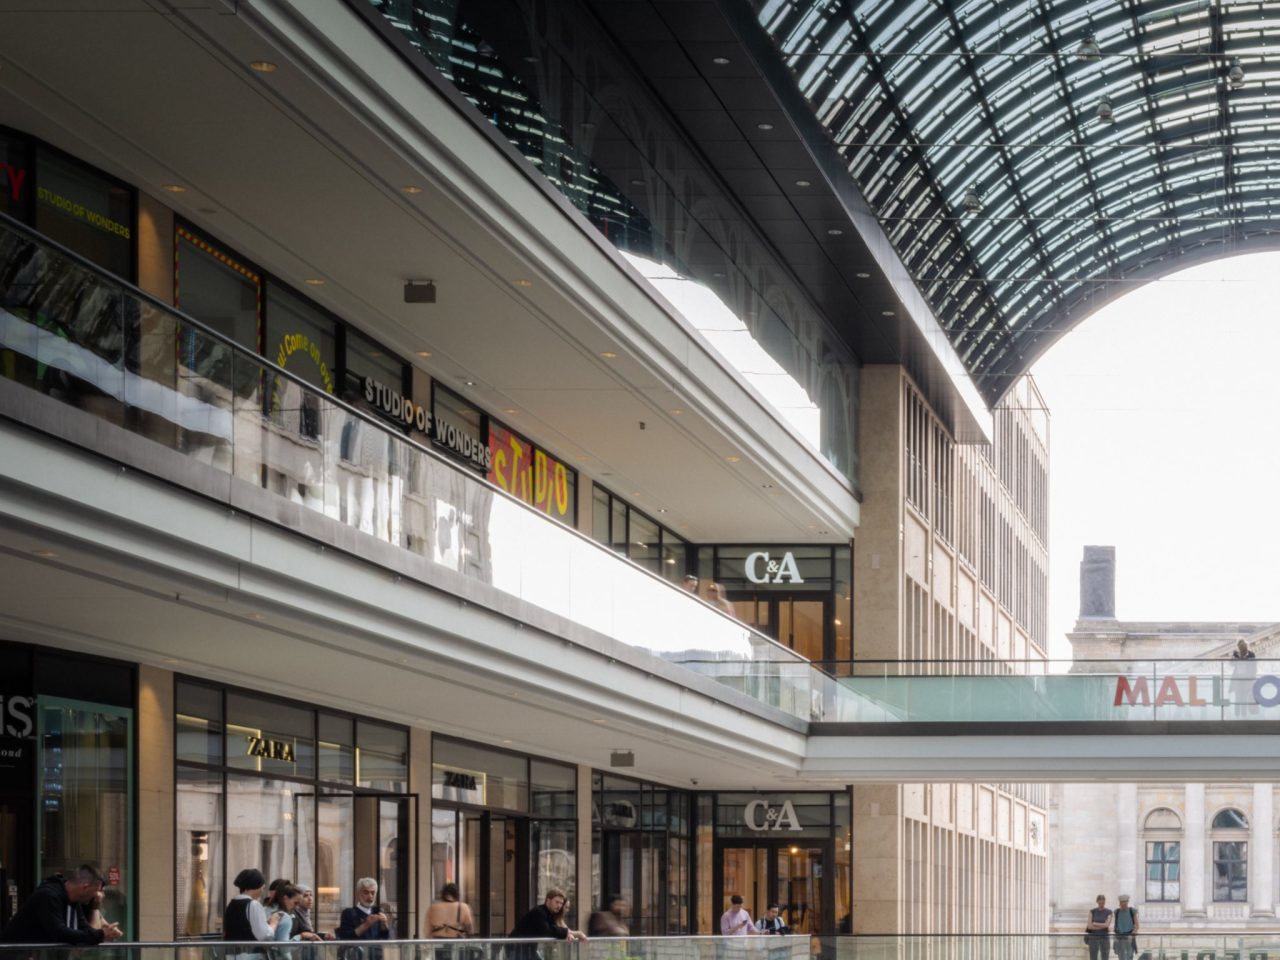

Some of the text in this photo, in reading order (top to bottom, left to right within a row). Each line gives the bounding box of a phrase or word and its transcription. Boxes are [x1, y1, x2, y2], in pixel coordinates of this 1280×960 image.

[38, 187, 130, 239] STUDIO OF WONDERS
[284, 334, 308, 355] Come
[365, 376, 491, 467] STUDIO OF WONDERS
[495, 436, 568, 516] STUDIO
[744, 552, 804, 584] C&A
[1113, 676, 1230, 707] MALL
[248, 736, 296, 763] ZARA
[744, 800, 803, 831] C&A
